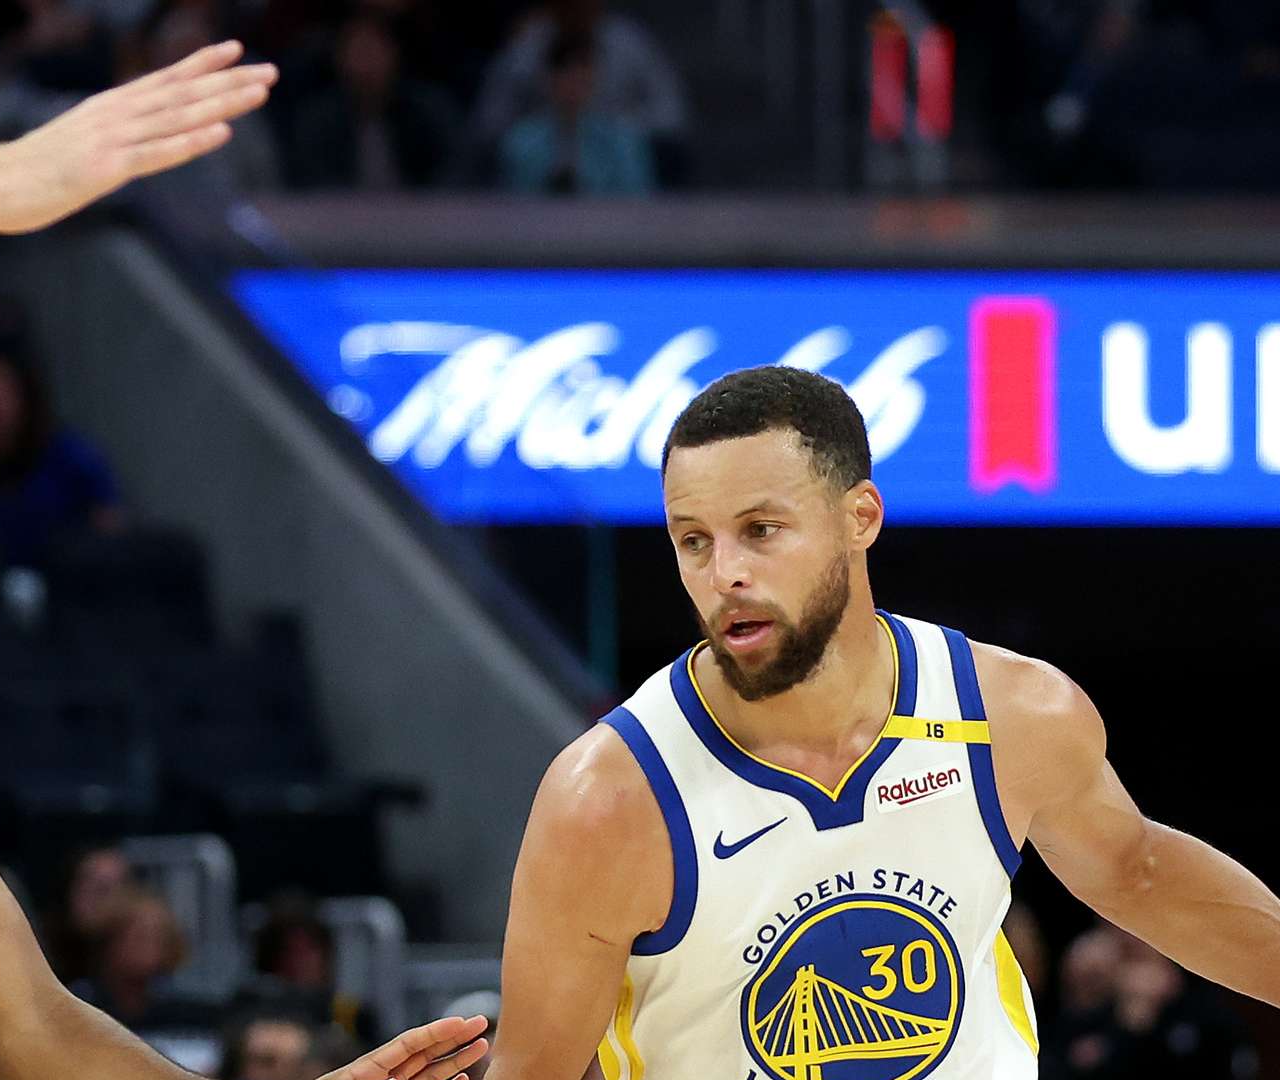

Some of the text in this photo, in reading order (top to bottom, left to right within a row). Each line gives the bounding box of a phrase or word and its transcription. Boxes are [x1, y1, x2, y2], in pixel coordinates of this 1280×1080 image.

[926, 723, 944, 738] 16
[877, 768, 961, 805] Rakuten
[742, 868, 957, 965] GOLDEN STATE
[861, 939, 937, 1001] 30
